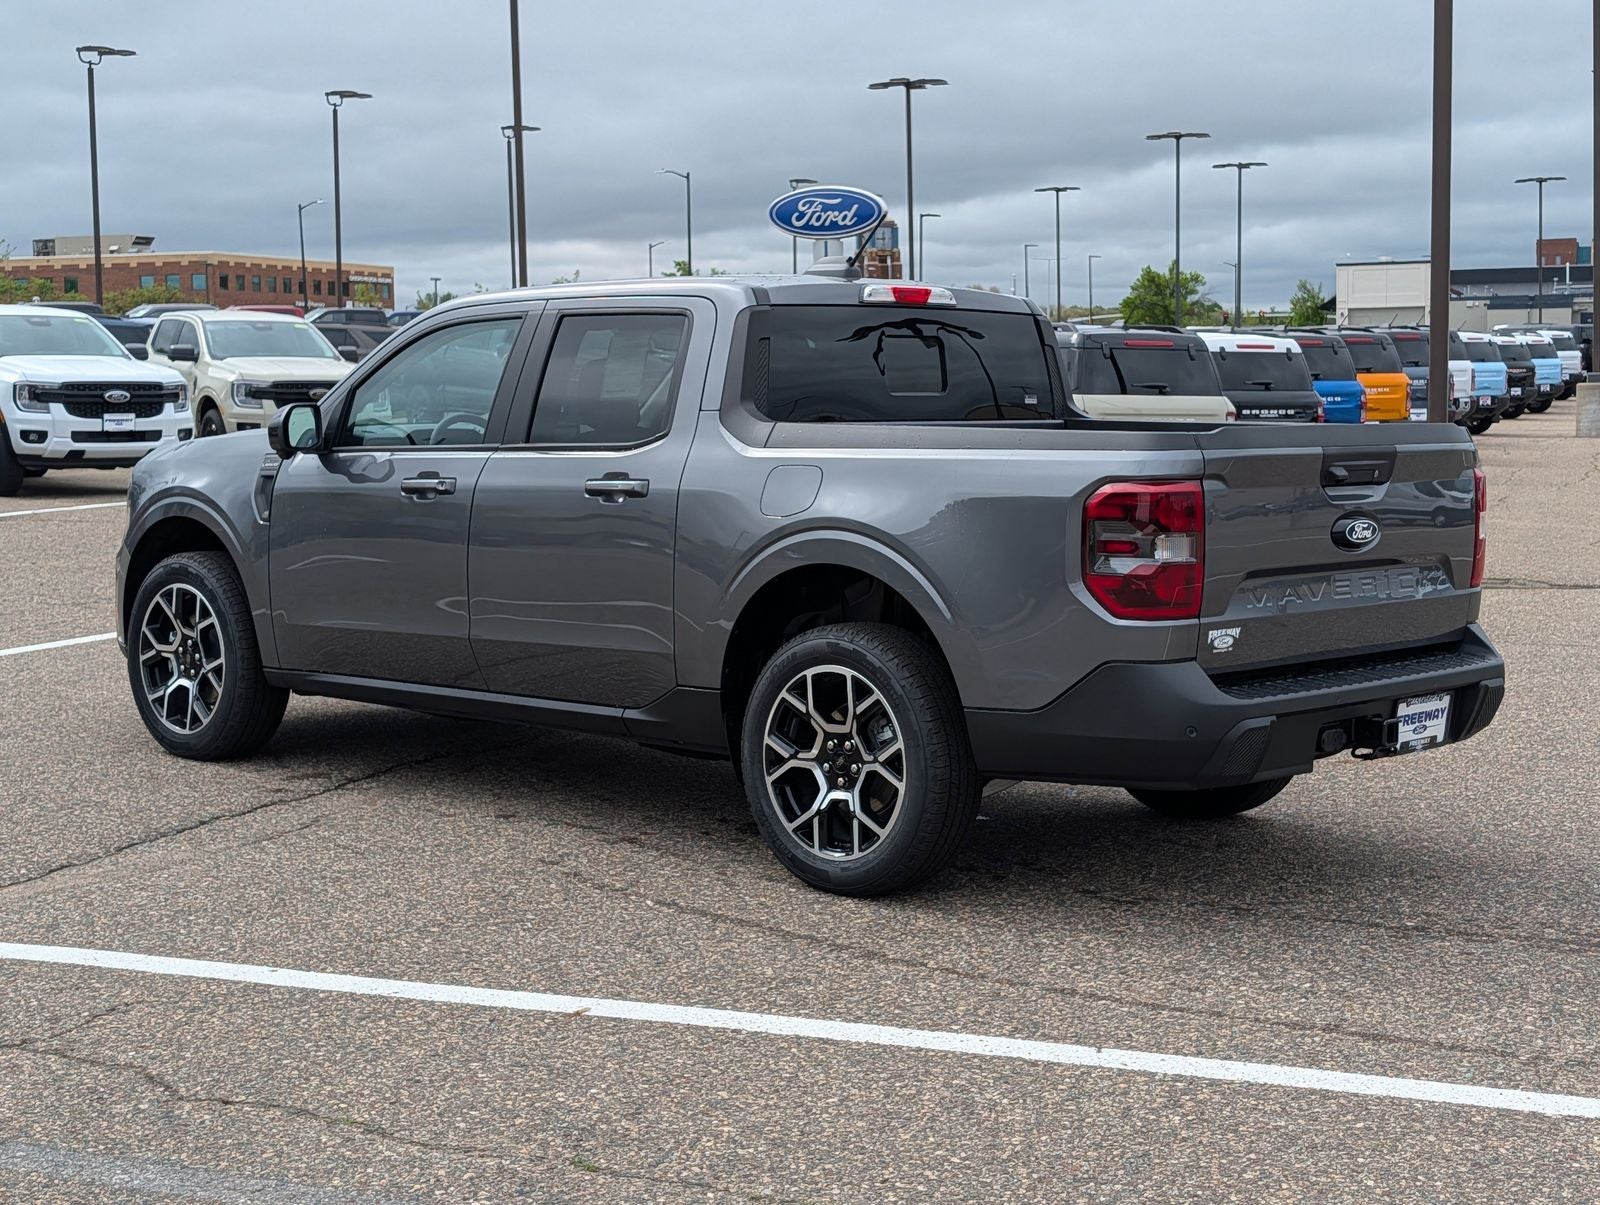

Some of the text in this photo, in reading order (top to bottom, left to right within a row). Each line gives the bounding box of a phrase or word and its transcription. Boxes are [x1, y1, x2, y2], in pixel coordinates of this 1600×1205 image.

[791, 198, 859, 227] Ford
[1352, 523, 1373, 539] Ford
[1207, 626, 1242, 645] FREEWAY
[1397, 706, 1447, 727] FREEWAY
